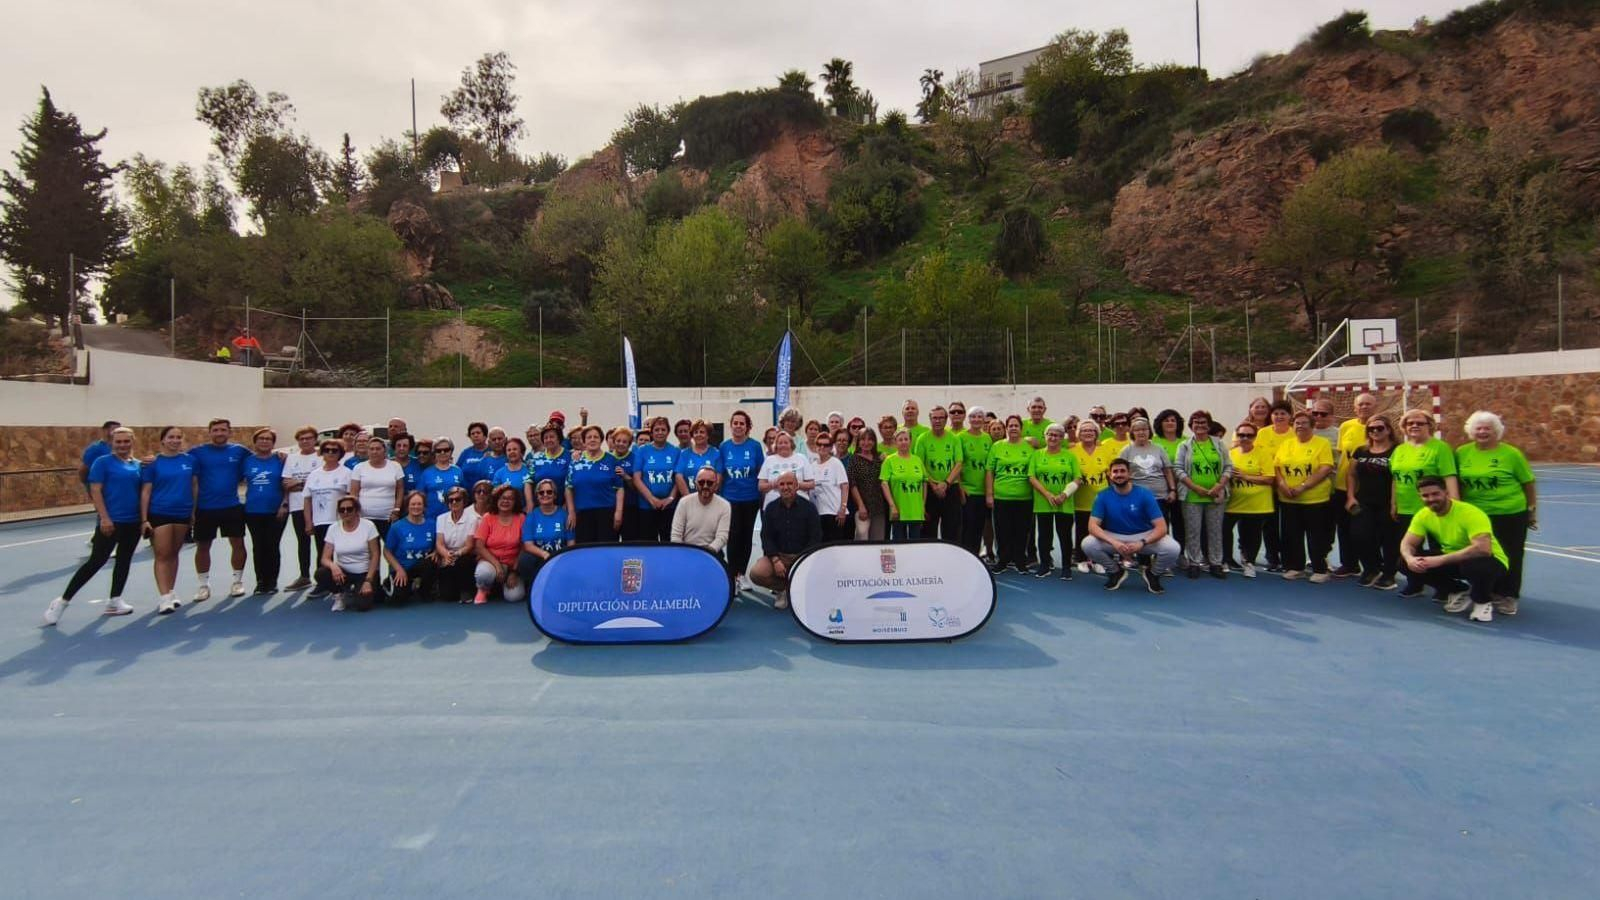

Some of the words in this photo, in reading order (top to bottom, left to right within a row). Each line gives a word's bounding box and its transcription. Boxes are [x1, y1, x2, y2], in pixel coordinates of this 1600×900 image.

[837, 578, 890, 588] DIPUTACIÓN
[892, 578, 903, 586] DE
[905, 576, 944, 585] ALMERÍA
[558, 598, 630, 613] DIPUTACIÓN
[632, 599, 649, 610] DE
[650, 596, 701, 610] ALMERÍA
